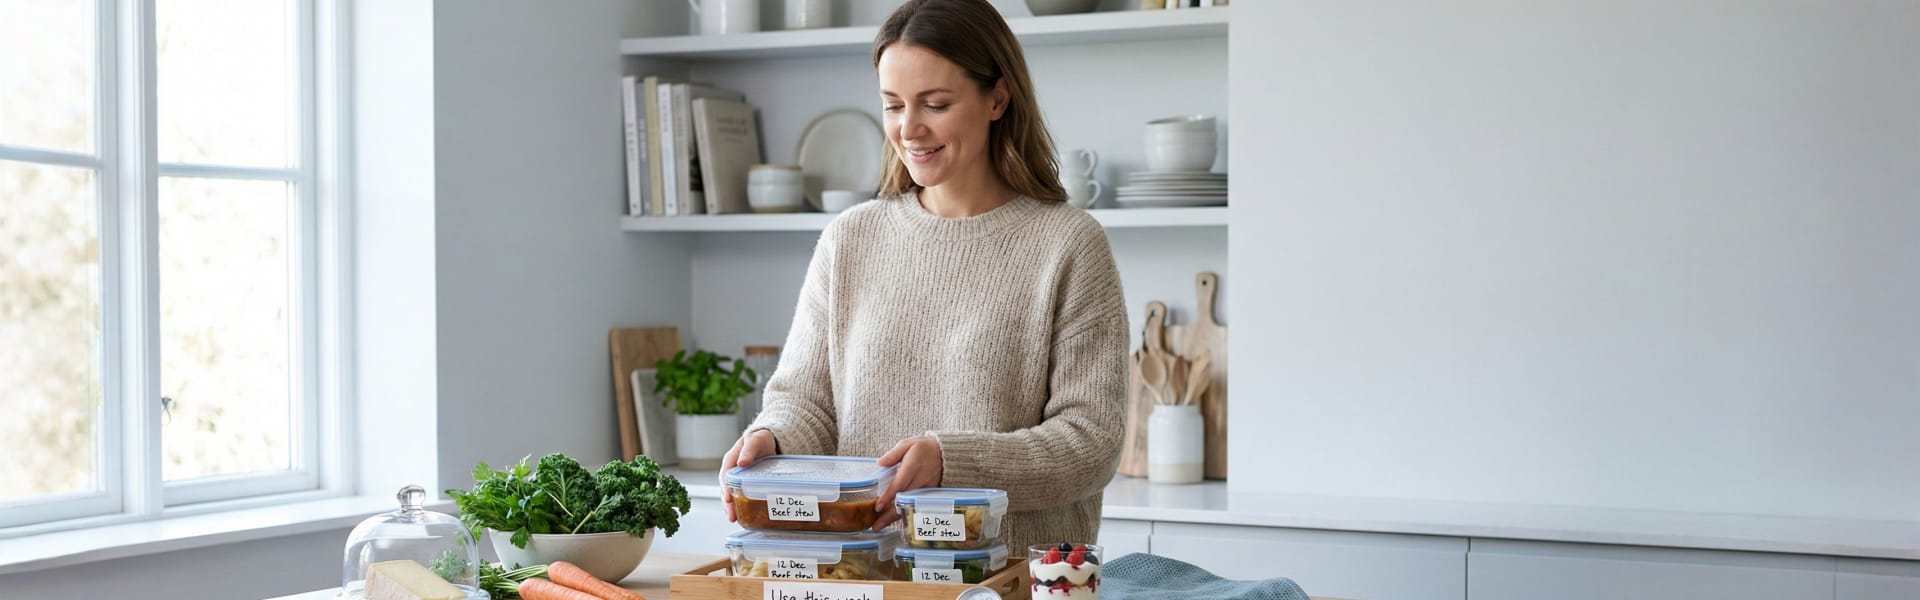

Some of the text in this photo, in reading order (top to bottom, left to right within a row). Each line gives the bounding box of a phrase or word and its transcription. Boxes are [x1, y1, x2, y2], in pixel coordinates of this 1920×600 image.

[775, 497, 805, 506] 12 Dec
[771, 507, 814, 517] Beef stew
[922, 517, 951, 526] 12 Dec
[917, 527, 961, 537] Beef stew
[777, 560, 806, 569] 12 Dec
[921, 571, 951, 581] 12 Dec
